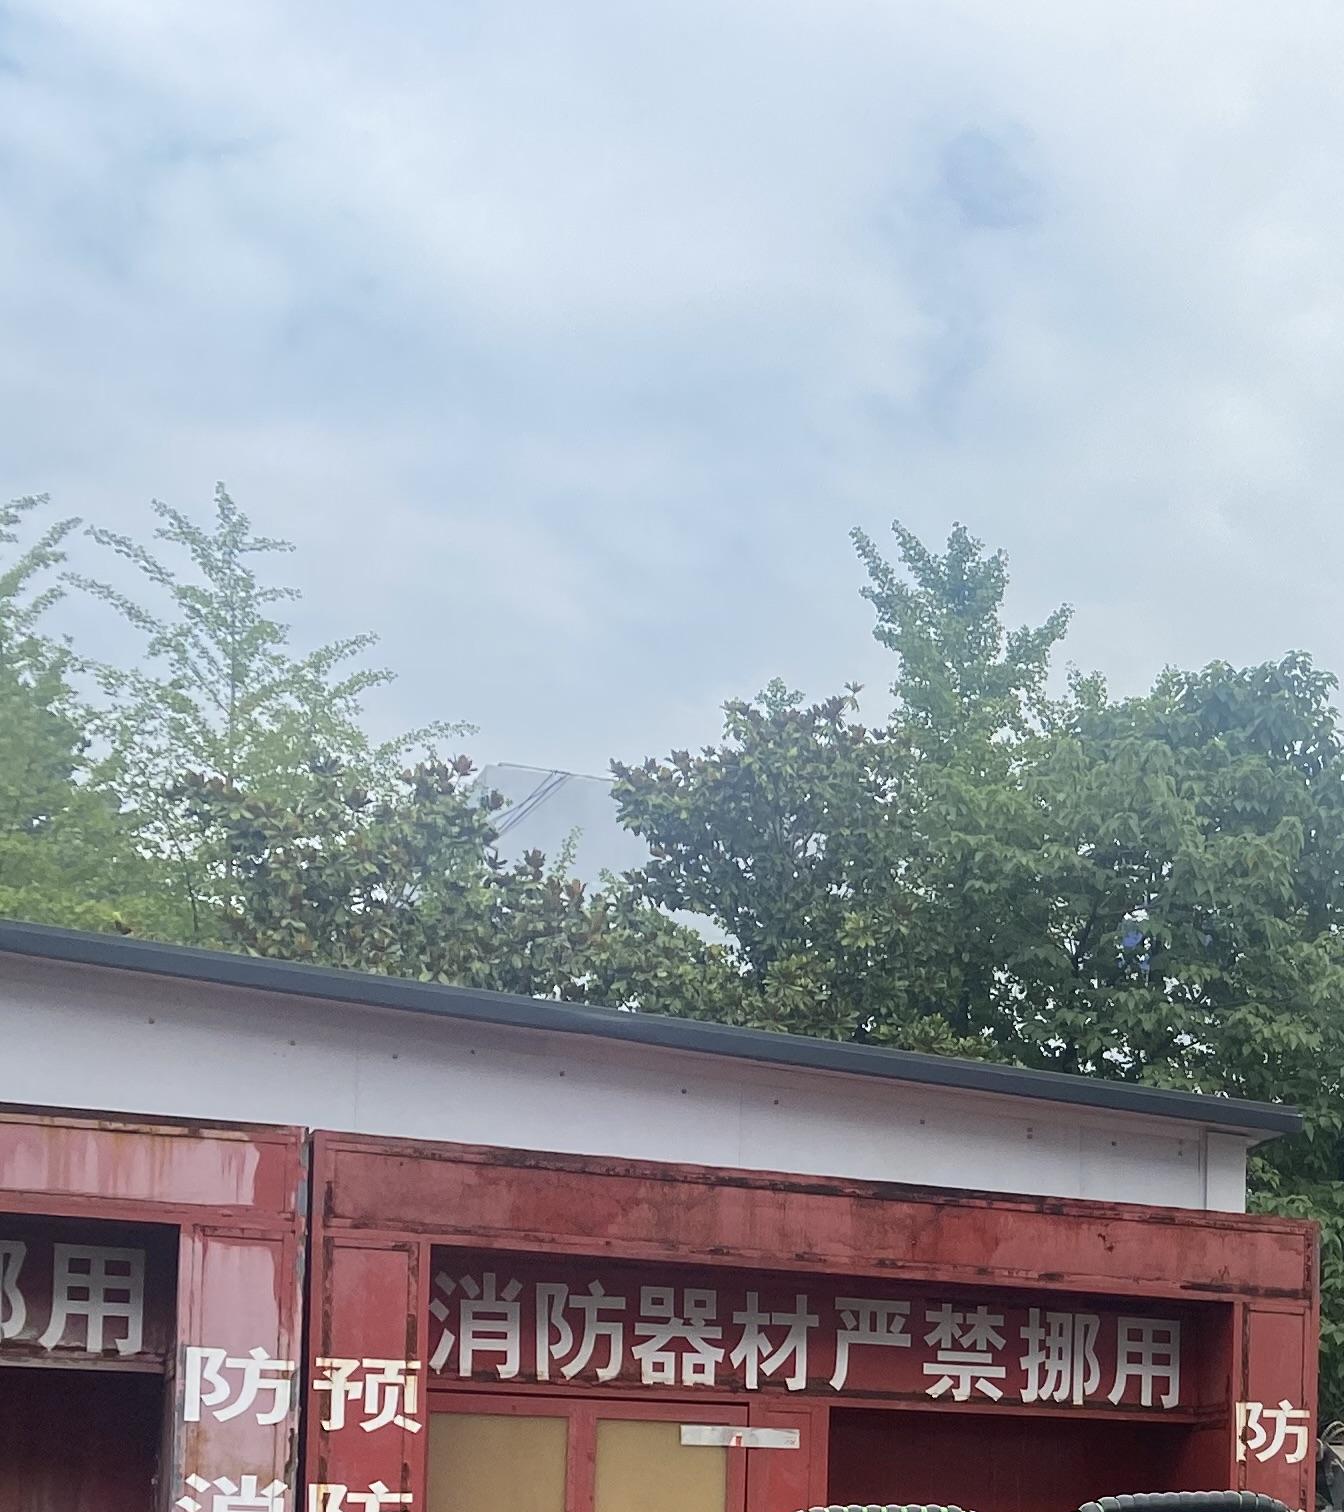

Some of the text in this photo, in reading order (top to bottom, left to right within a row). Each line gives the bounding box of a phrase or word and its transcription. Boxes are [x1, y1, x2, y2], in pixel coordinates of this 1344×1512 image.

[428, 1271, 1182, 1409] 消防器材严禁挪用
